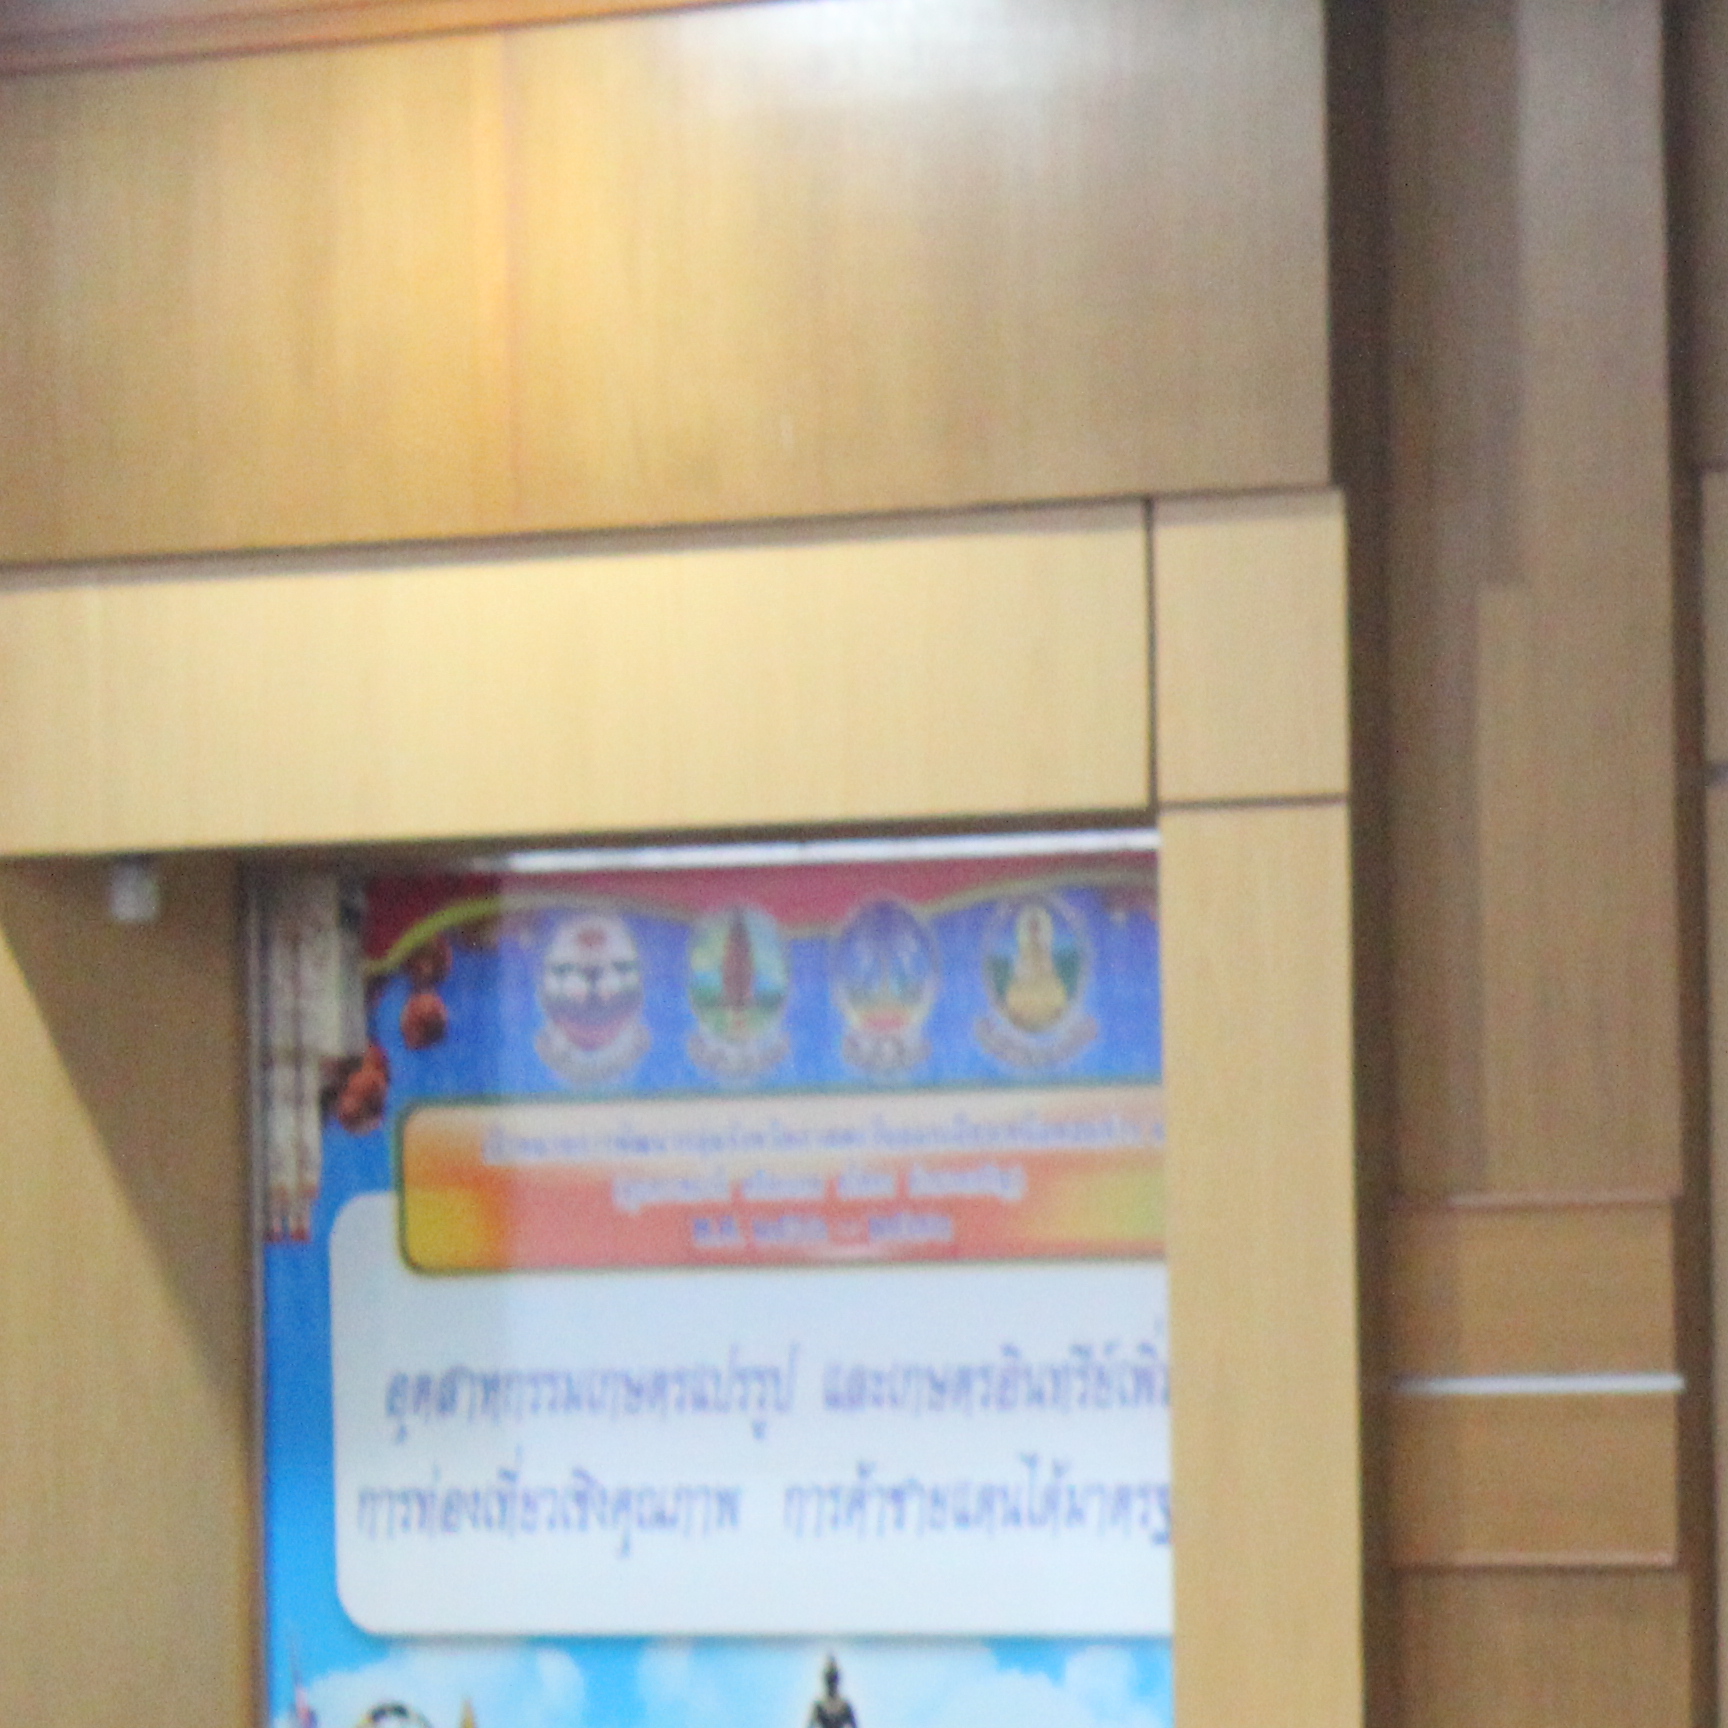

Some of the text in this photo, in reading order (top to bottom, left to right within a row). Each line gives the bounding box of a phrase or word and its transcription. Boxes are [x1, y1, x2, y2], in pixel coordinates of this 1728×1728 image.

[385, 1316, 1170, 1440] อุตสาหกรรมเกษตรแปรรูป และเกษตรอินทรีย์เพิ่
[356, 1446, 742, 1558] การท่องเที่ยวเชิงคุณภาพ
